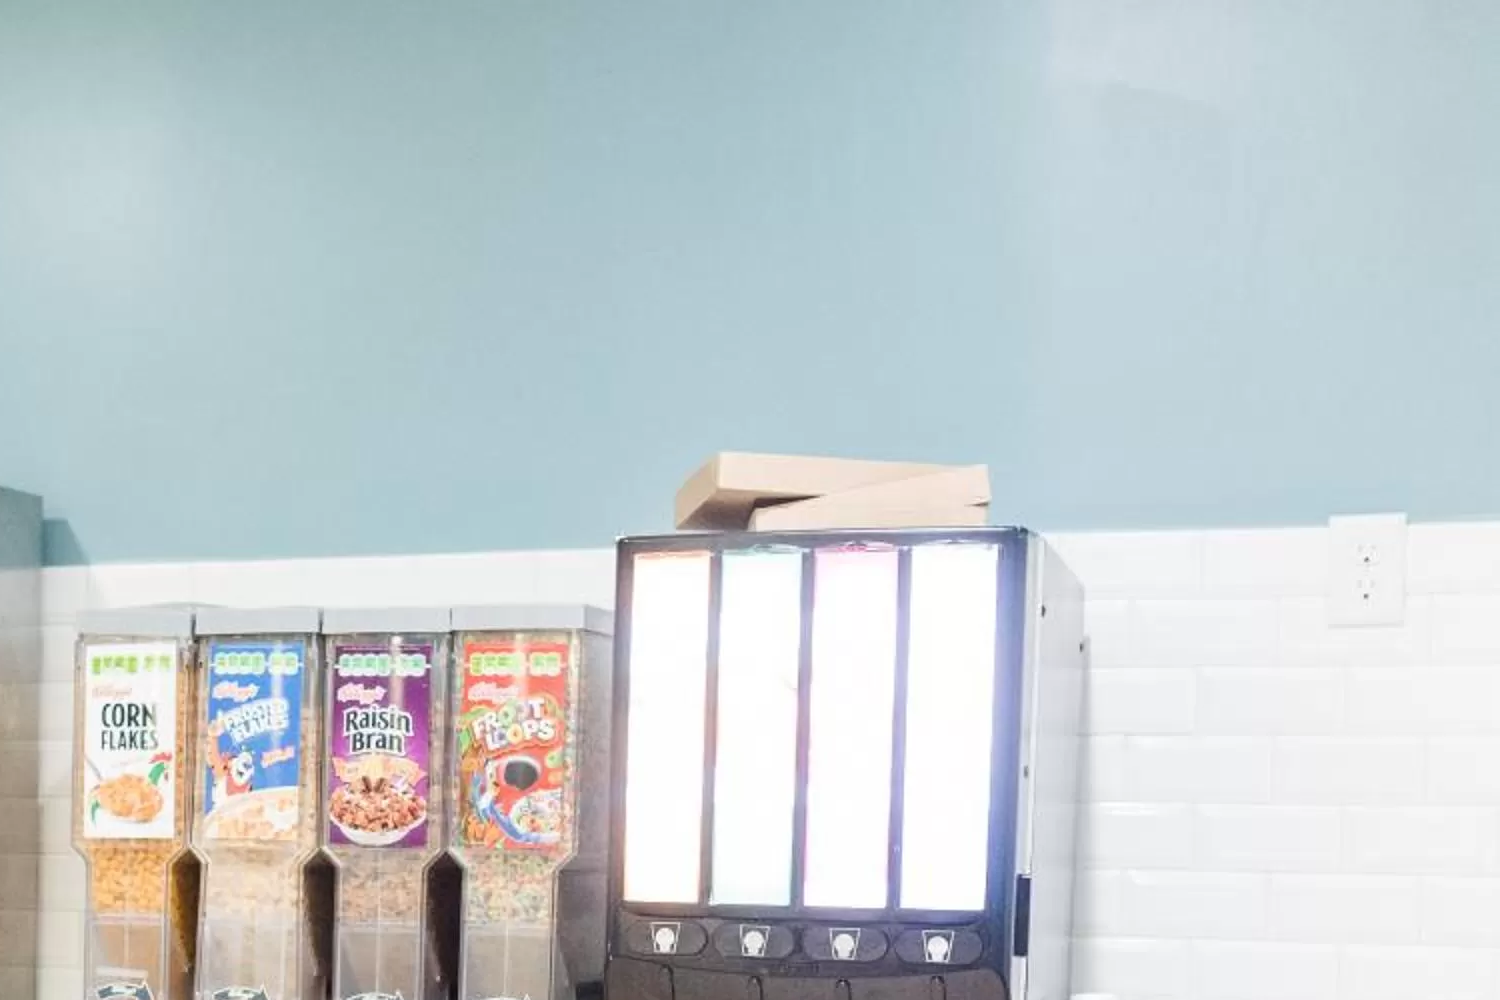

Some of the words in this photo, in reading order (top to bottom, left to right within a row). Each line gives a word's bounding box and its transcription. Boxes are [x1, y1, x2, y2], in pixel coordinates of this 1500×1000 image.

[101, 703, 157, 728] CORN
[345, 705, 411, 733] Raisin
[101, 730, 159, 751] FLAKES
[351, 731, 403, 753] Bran
